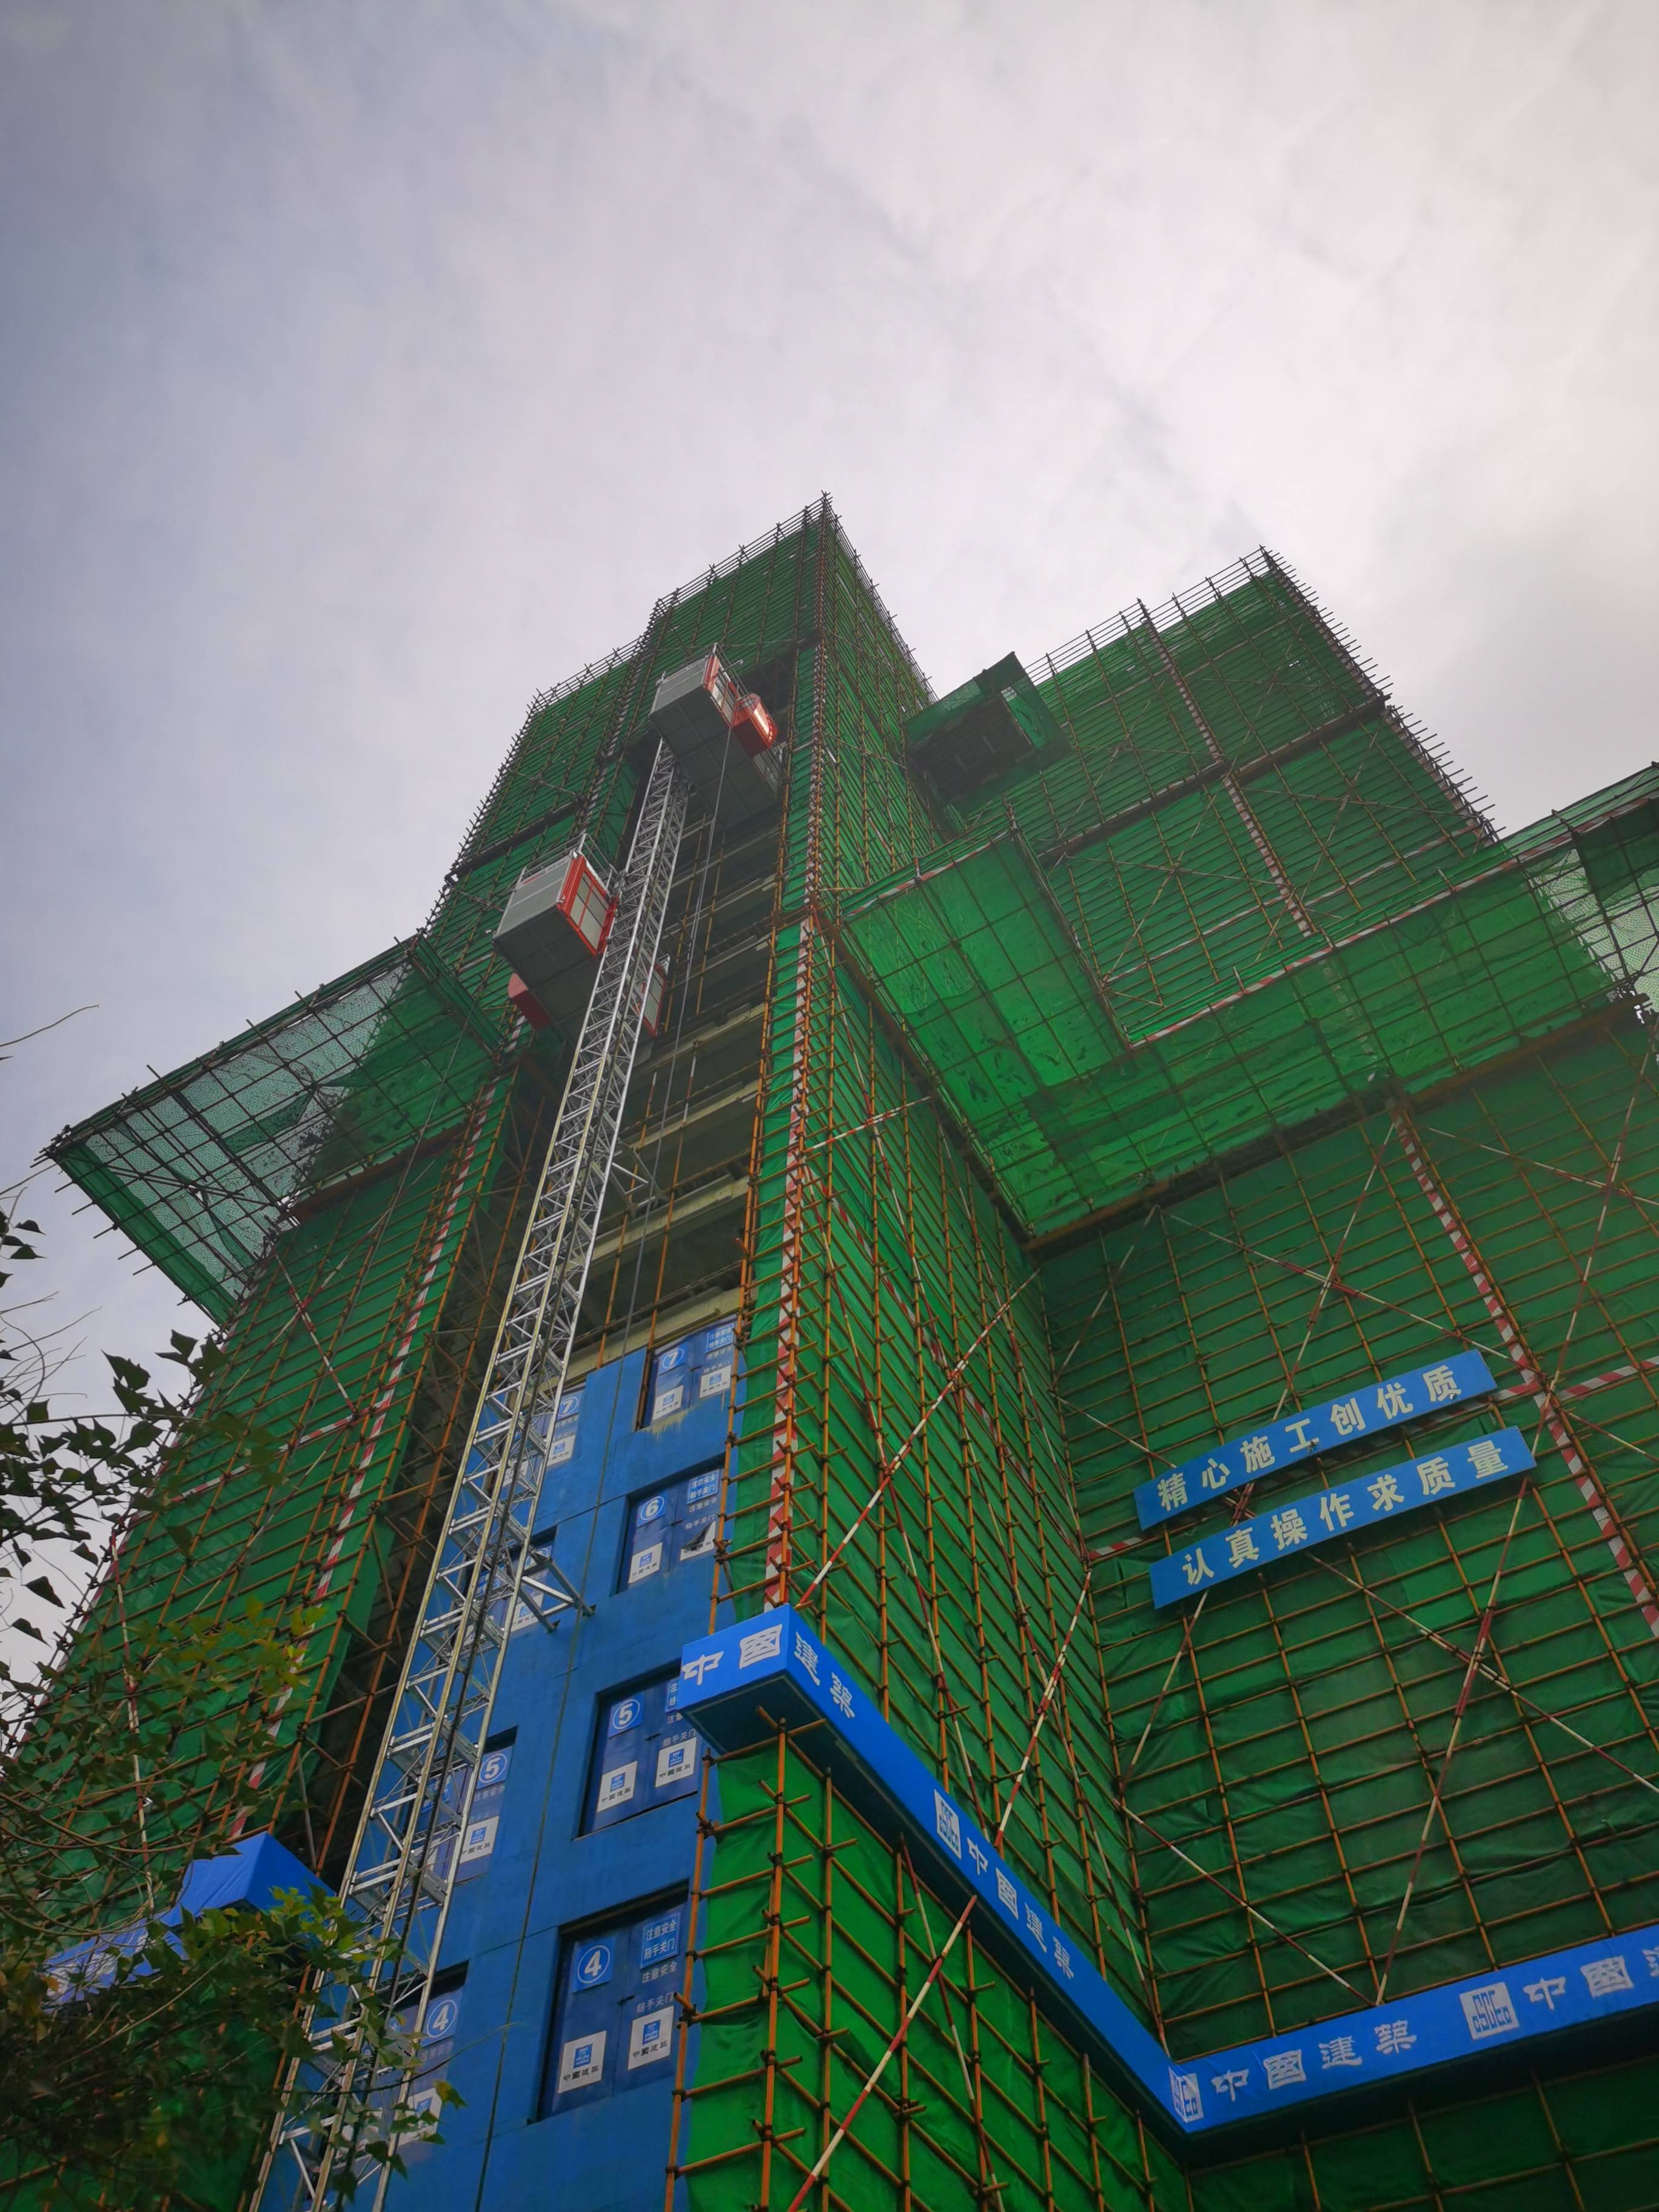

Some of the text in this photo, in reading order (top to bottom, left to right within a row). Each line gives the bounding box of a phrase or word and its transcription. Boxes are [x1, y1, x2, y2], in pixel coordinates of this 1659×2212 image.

[1157, 1364, 1461, 1512] 精心施工创优质
[1182, 1439, 1508, 1586] 认真操作求质量
[645, 1920, 677, 1942] 注意安全
[644, 1937, 675, 1960] 随手关门
[642, 1960, 678, 1984] 注意安全
